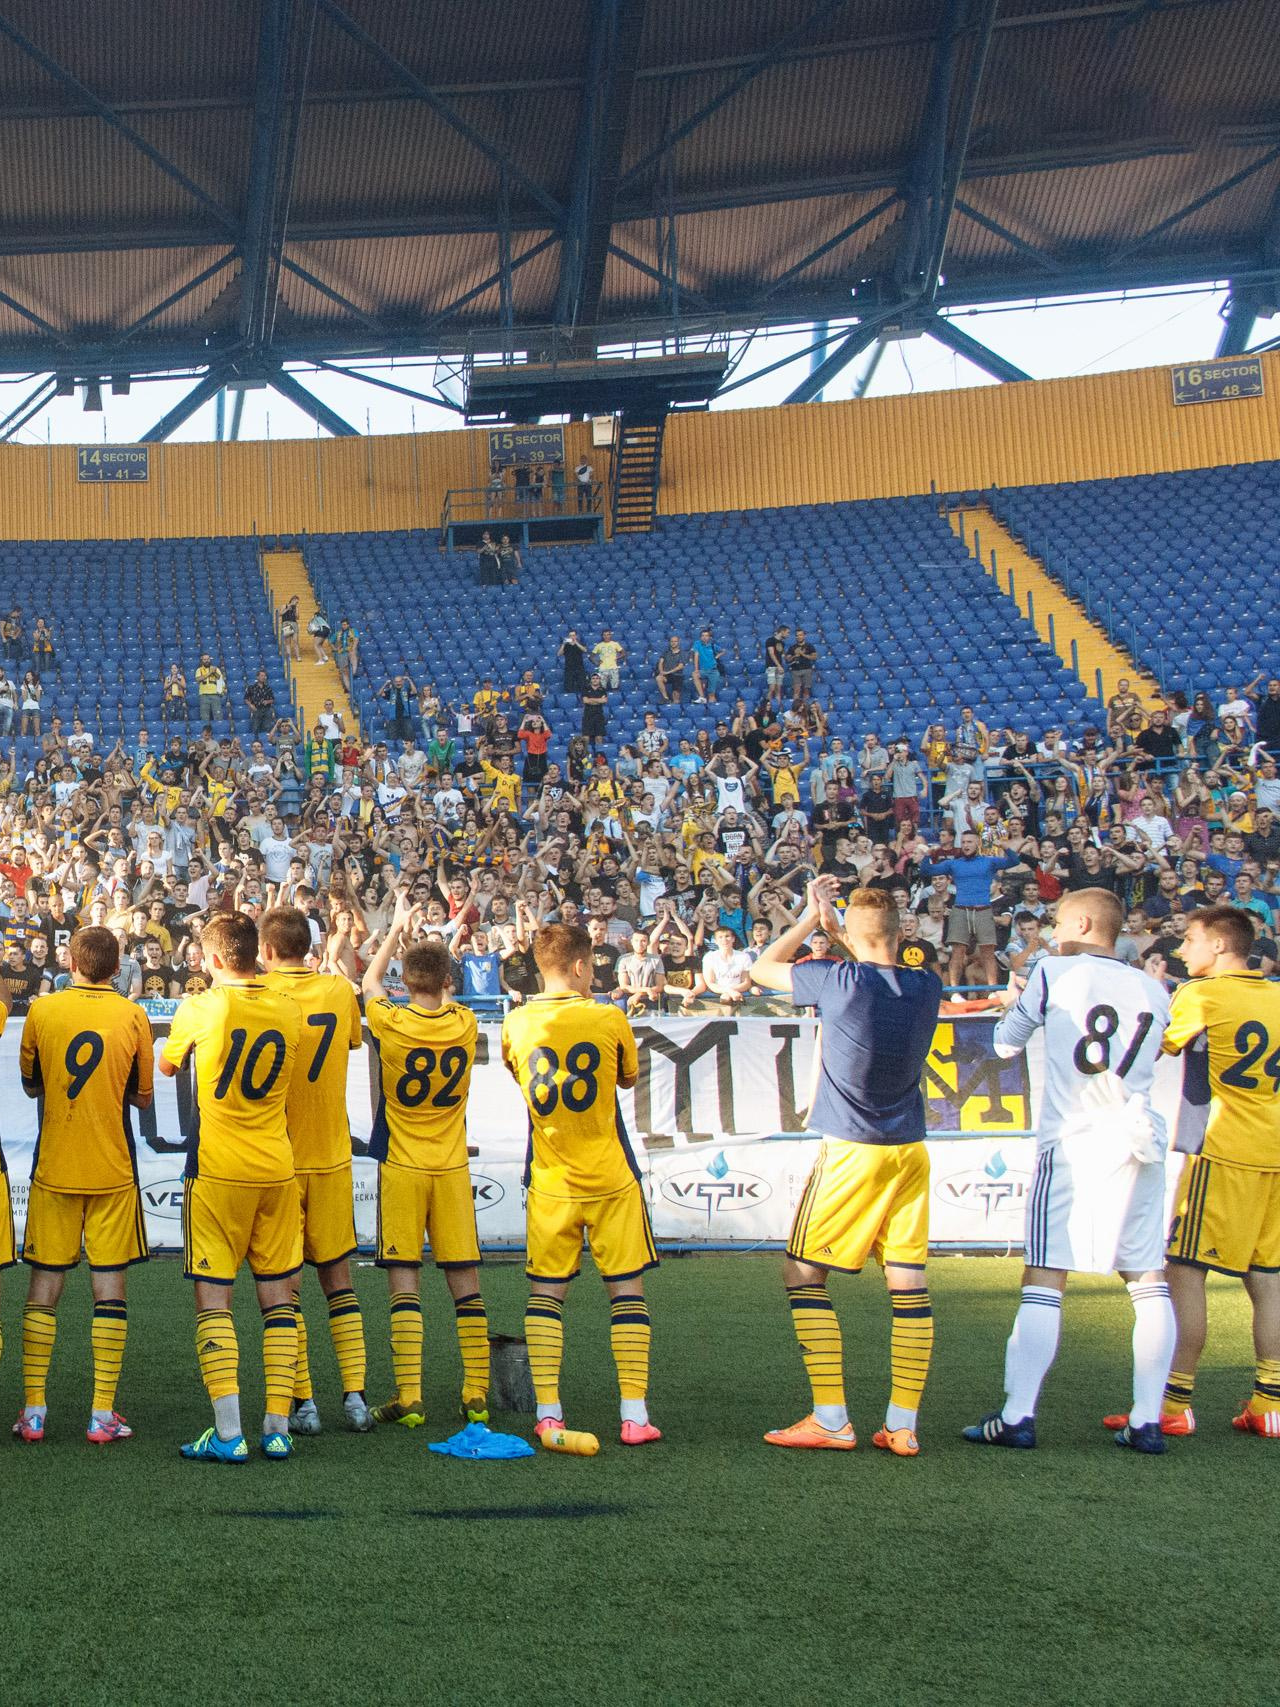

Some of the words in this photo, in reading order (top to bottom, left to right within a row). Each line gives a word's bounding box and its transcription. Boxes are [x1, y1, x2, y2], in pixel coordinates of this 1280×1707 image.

[1175, 368, 1202, 387] 16
[1204, 365, 1259, 381] SECTOR
[1221, 385, 1240, 396] 48
[80, 449, 101, 466] 14
[102, 453, 146, 462] SECTOR
[491, 434, 514, 450] 15
[515, 433, 561, 445] SECTOR
[529, 451, 545, 461] 39
[115, 469, 129, 479] 41
[307, 1012, 337, 1083] 7
[1074, 1004, 1154, 1076] 81
[65, 1030, 104, 1099] 9
[217, 1028, 286, 1100] 10
[395, 1046, 469, 1107] 82
[528, 1041, 601, 1116] 88
